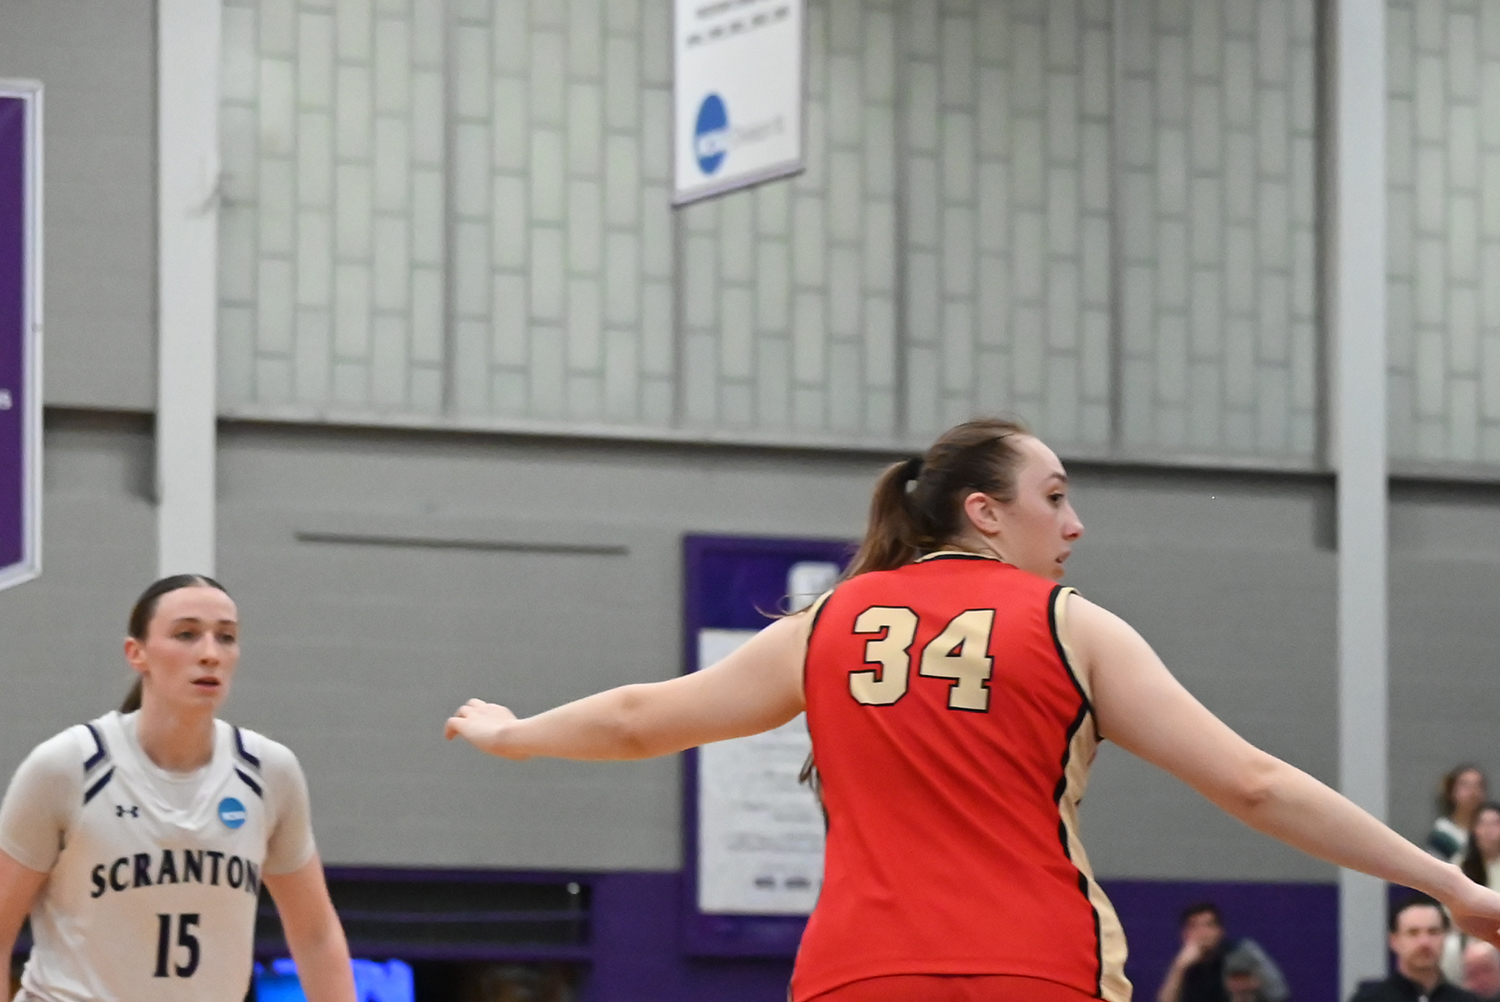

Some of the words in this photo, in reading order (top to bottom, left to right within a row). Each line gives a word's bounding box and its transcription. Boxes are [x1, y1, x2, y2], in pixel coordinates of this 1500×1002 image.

[849, 605, 996, 713] 34
[90, 849, 259, 898] SCRANTON
[153, 913, 200, 978] 15
